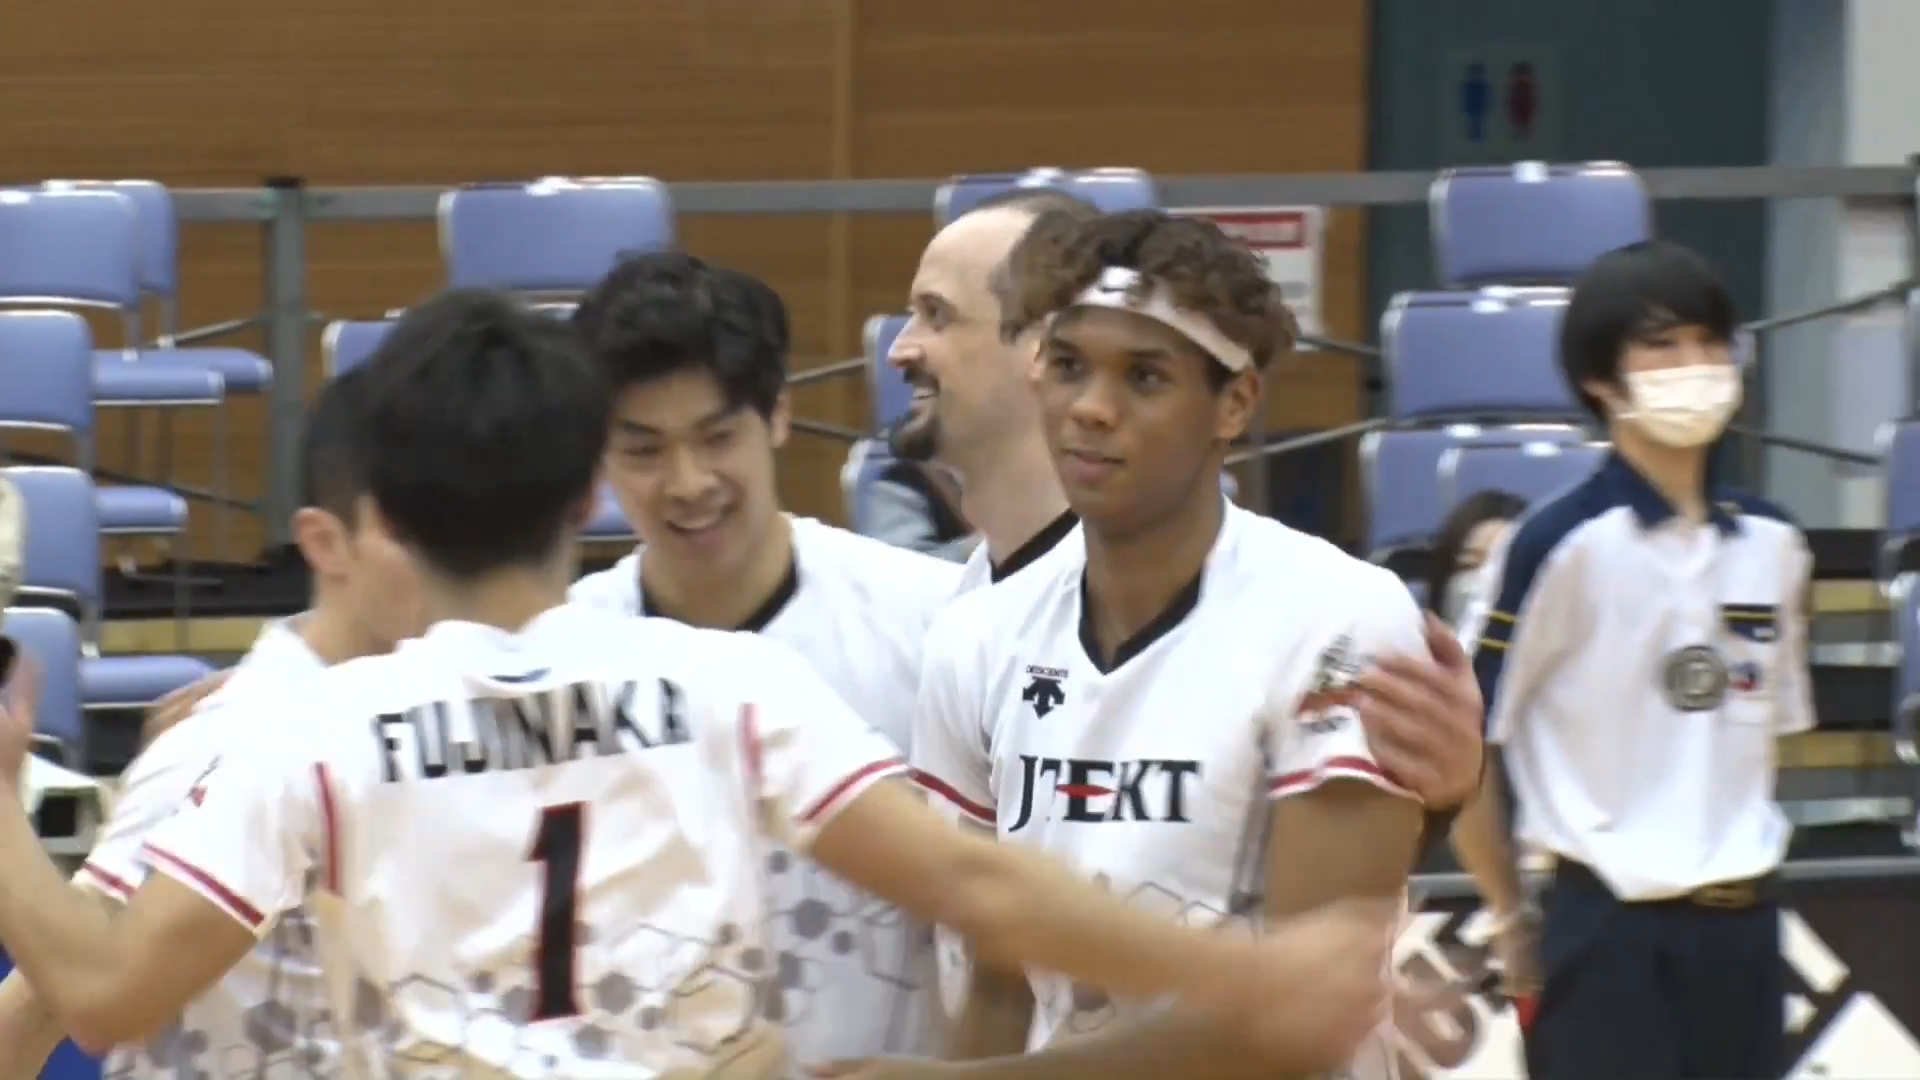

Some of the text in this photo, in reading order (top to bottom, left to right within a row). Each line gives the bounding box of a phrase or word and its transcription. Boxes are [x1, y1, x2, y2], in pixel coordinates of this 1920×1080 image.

[370, 677, 692, 782] FUJINAKA
[1008, 754, 1203, 832] JTEKT
[525, 801, 590, 1024] 1
